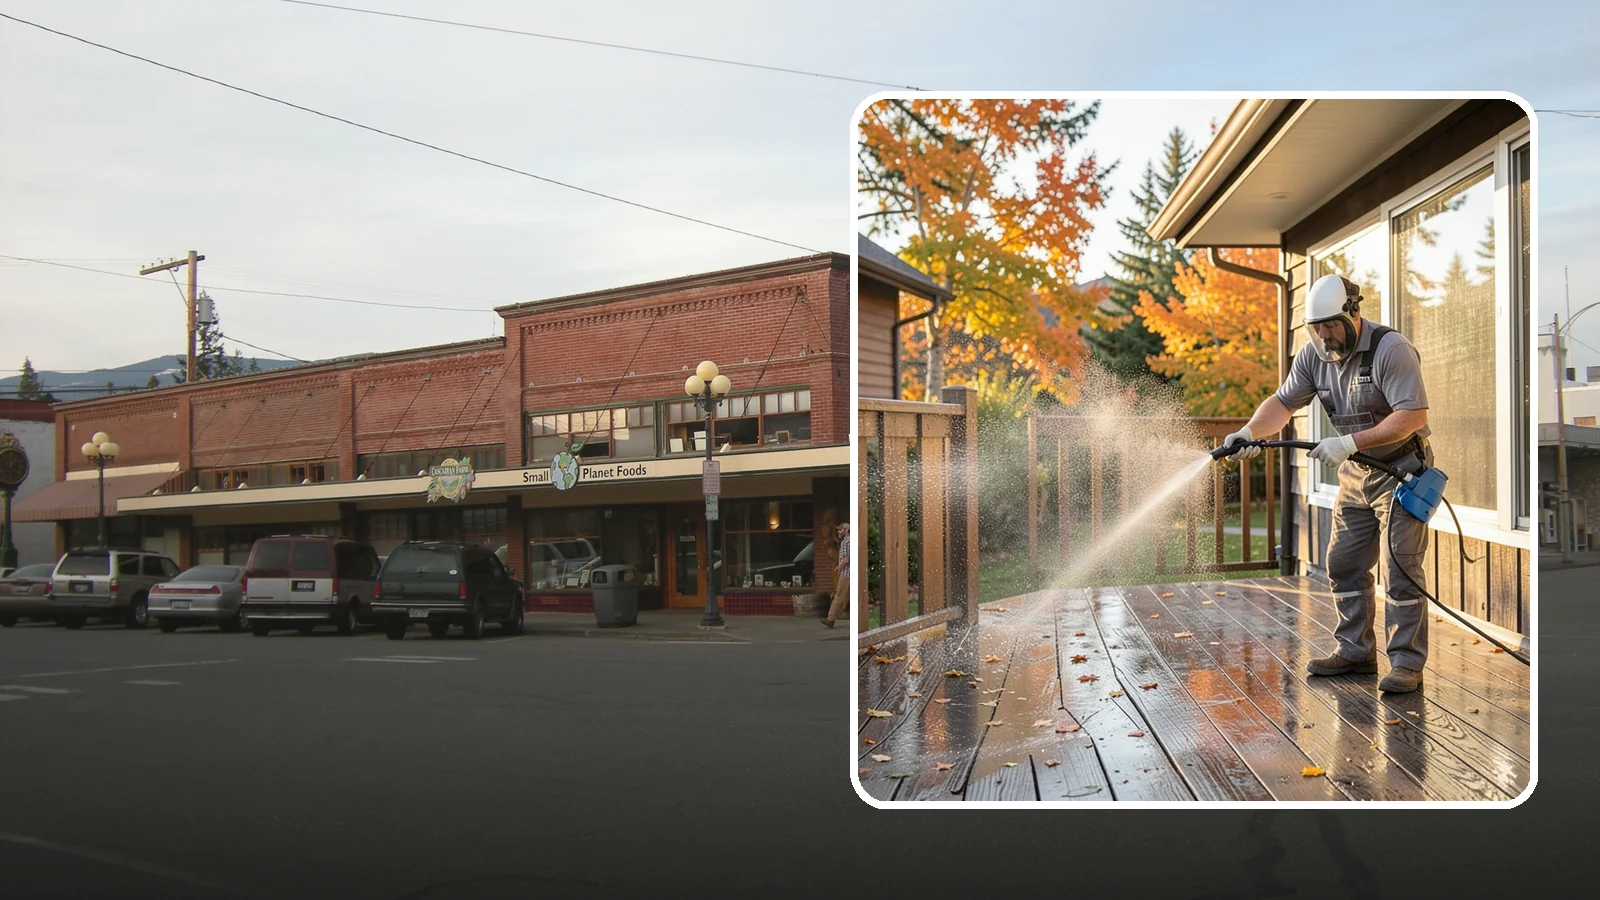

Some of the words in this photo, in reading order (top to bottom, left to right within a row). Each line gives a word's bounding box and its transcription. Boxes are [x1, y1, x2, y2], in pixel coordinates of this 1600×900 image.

[431, 466, 455, 476] CASCADIAN
[523, 470, 549, 483] Small
[583, 467, 614, 479] Planet
[617, 464, 647, 477] Foods
